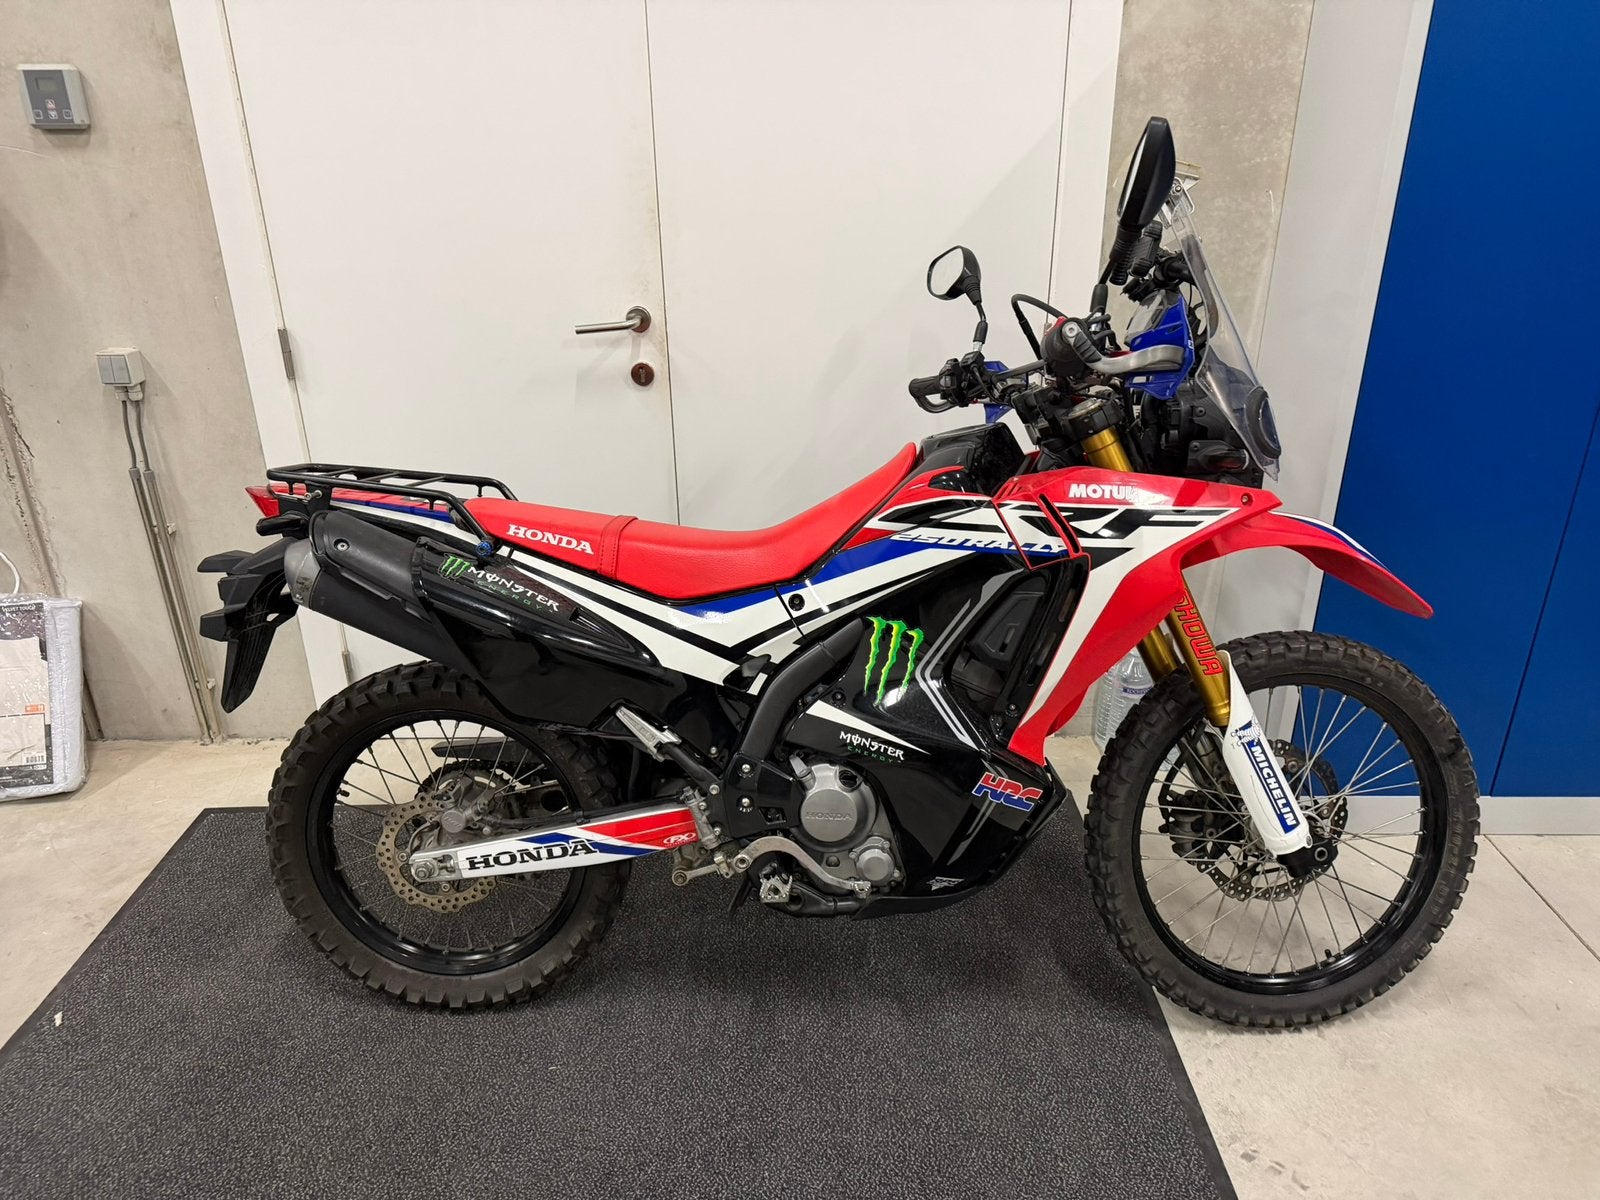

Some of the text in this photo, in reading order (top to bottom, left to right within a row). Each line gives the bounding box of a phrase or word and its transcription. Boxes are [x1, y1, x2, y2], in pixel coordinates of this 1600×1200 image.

[506, 523, 594, 555] HONDA
[468, 566, 560, 612] MONSTER
[477, 580, 543, 609] ENERGY
[839, 730, 905, 761] MONSTER
[847, 745, 894, 764] ENERGY
[972, 771, 1043, 812] HRC
[1251, 745, 1297, 828] MICHELIN
[805, 811, 853, 821] HONDA
[465, 839, 598, 870] HONDA
